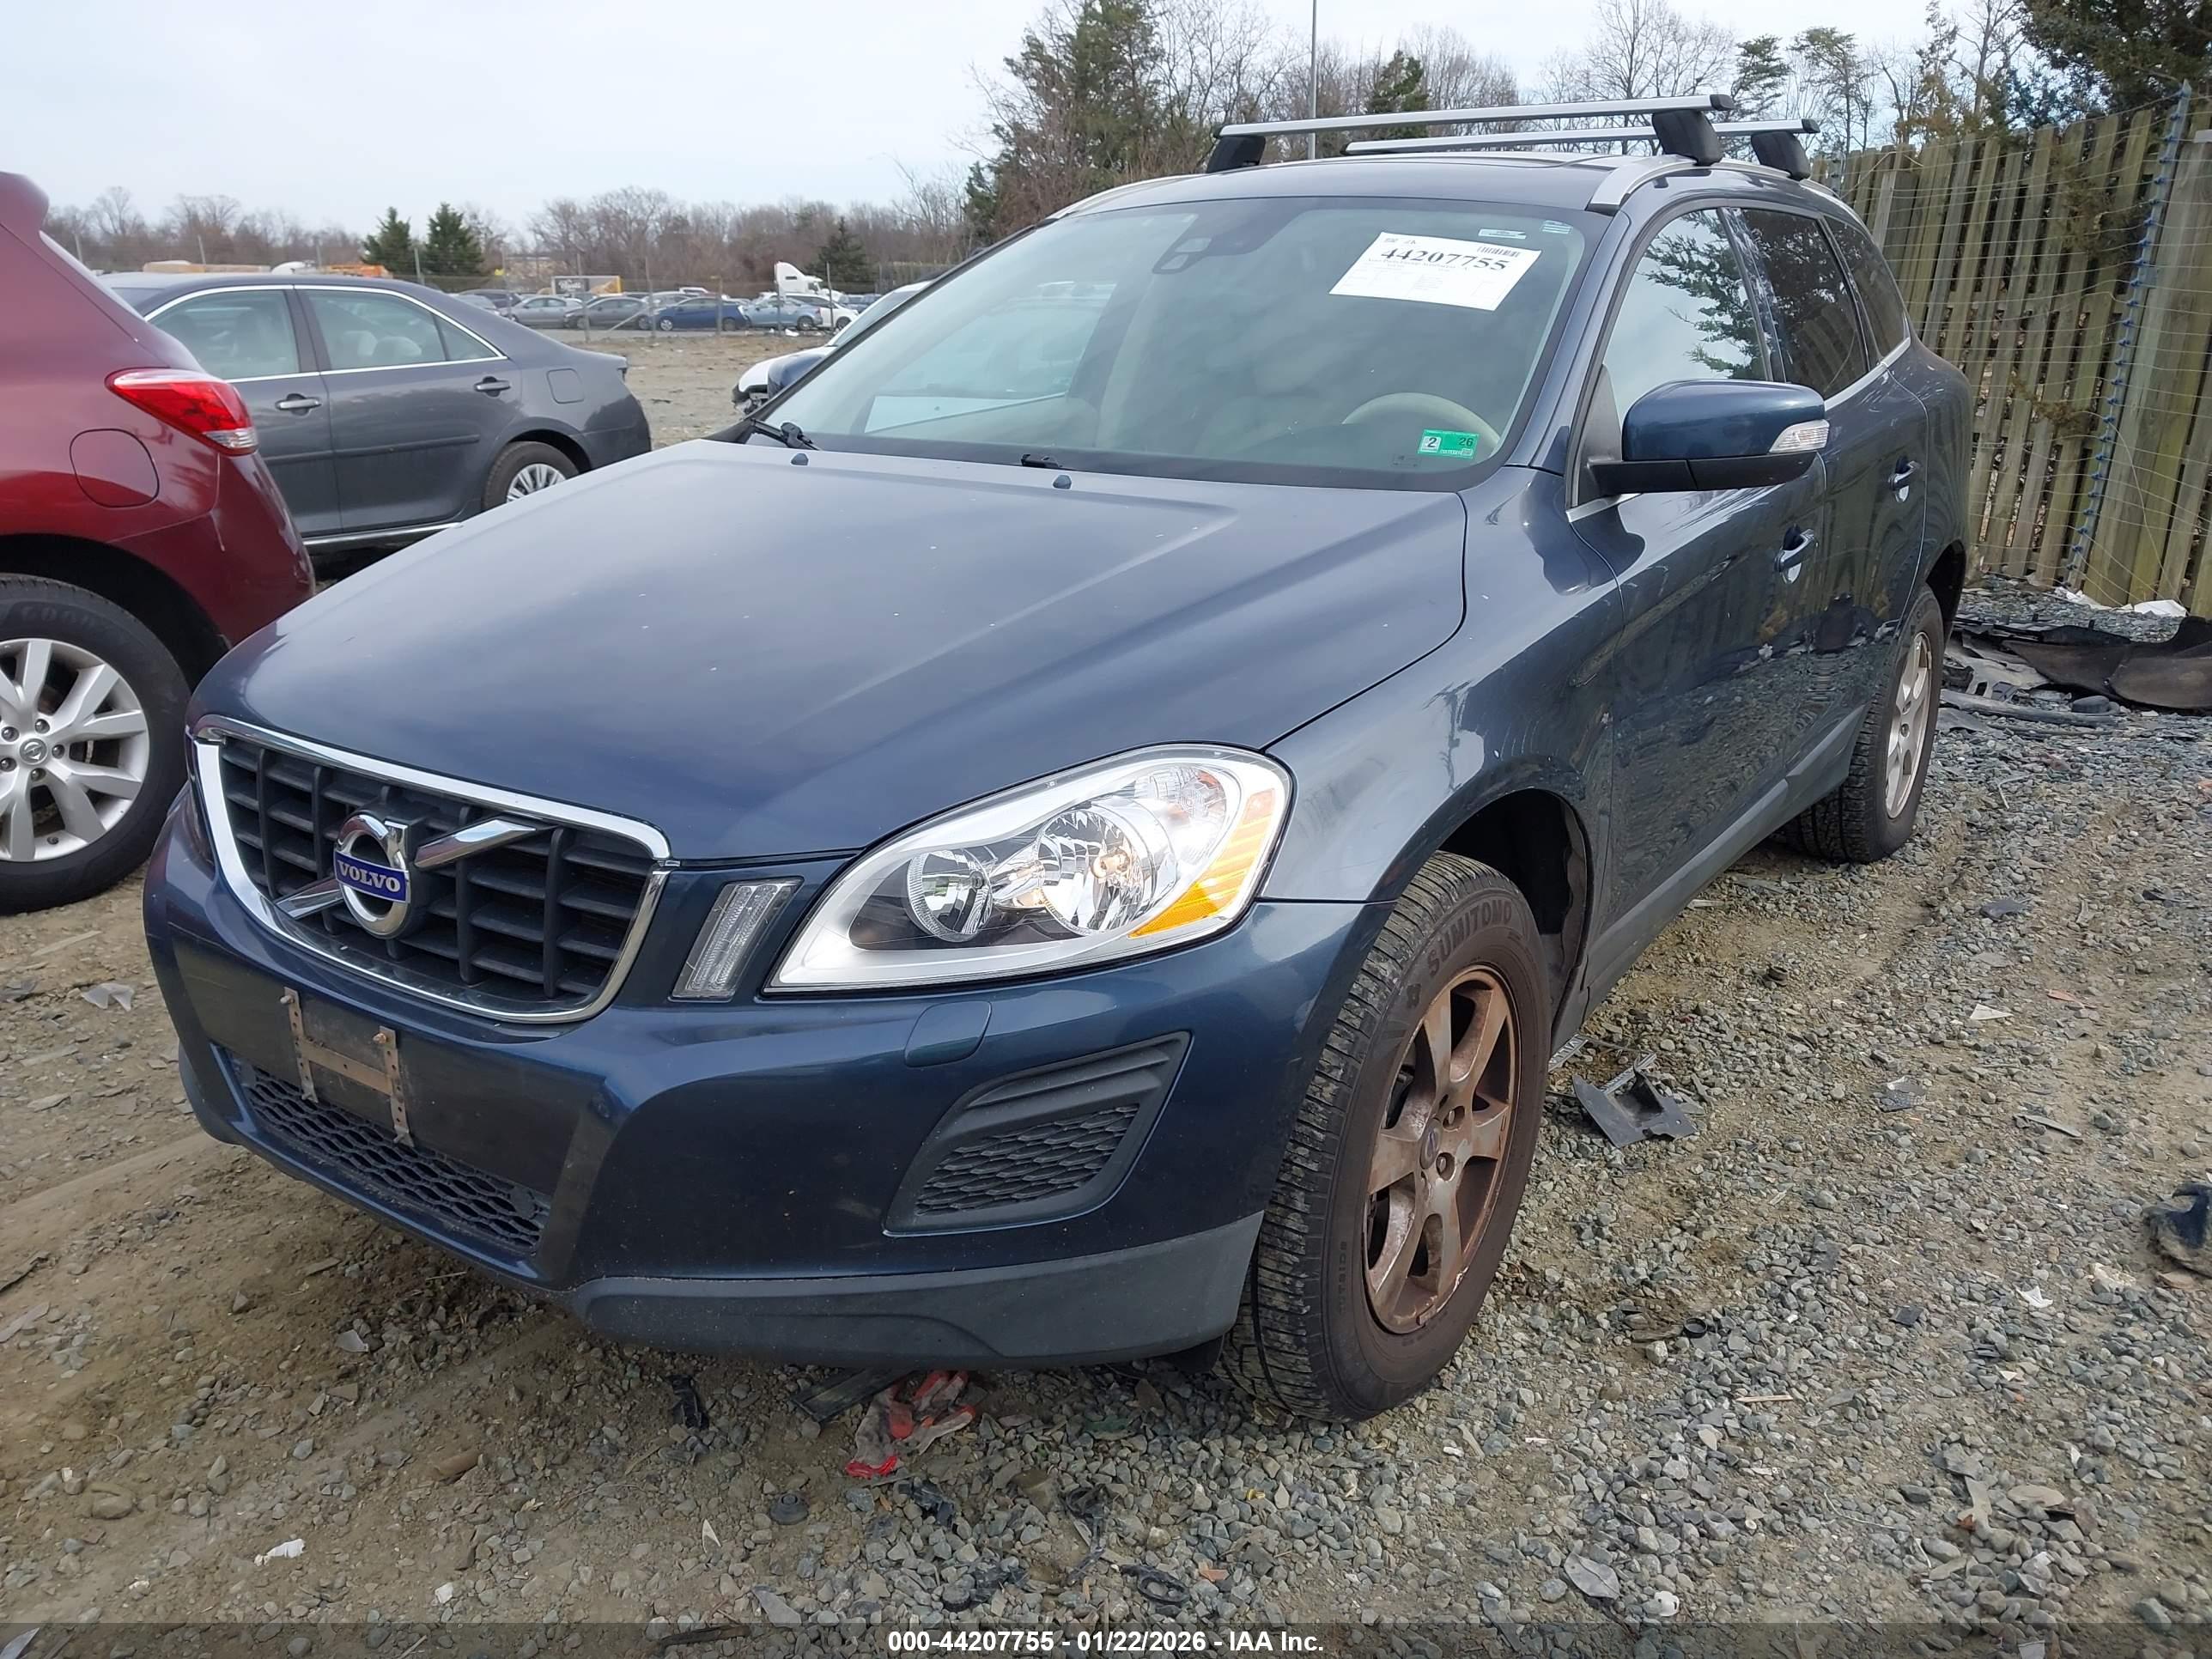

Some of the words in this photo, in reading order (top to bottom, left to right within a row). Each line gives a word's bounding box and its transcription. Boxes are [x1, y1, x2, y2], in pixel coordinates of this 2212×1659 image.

[1381, 247, 1511, 271] 44207755
[1427, 437, 1437, 447] 2
[1459, 437, 1474, 447] 26
[337, 860, 401, 892] VOLVO
[1428, 899, 1511, 977] SUMITOMO
